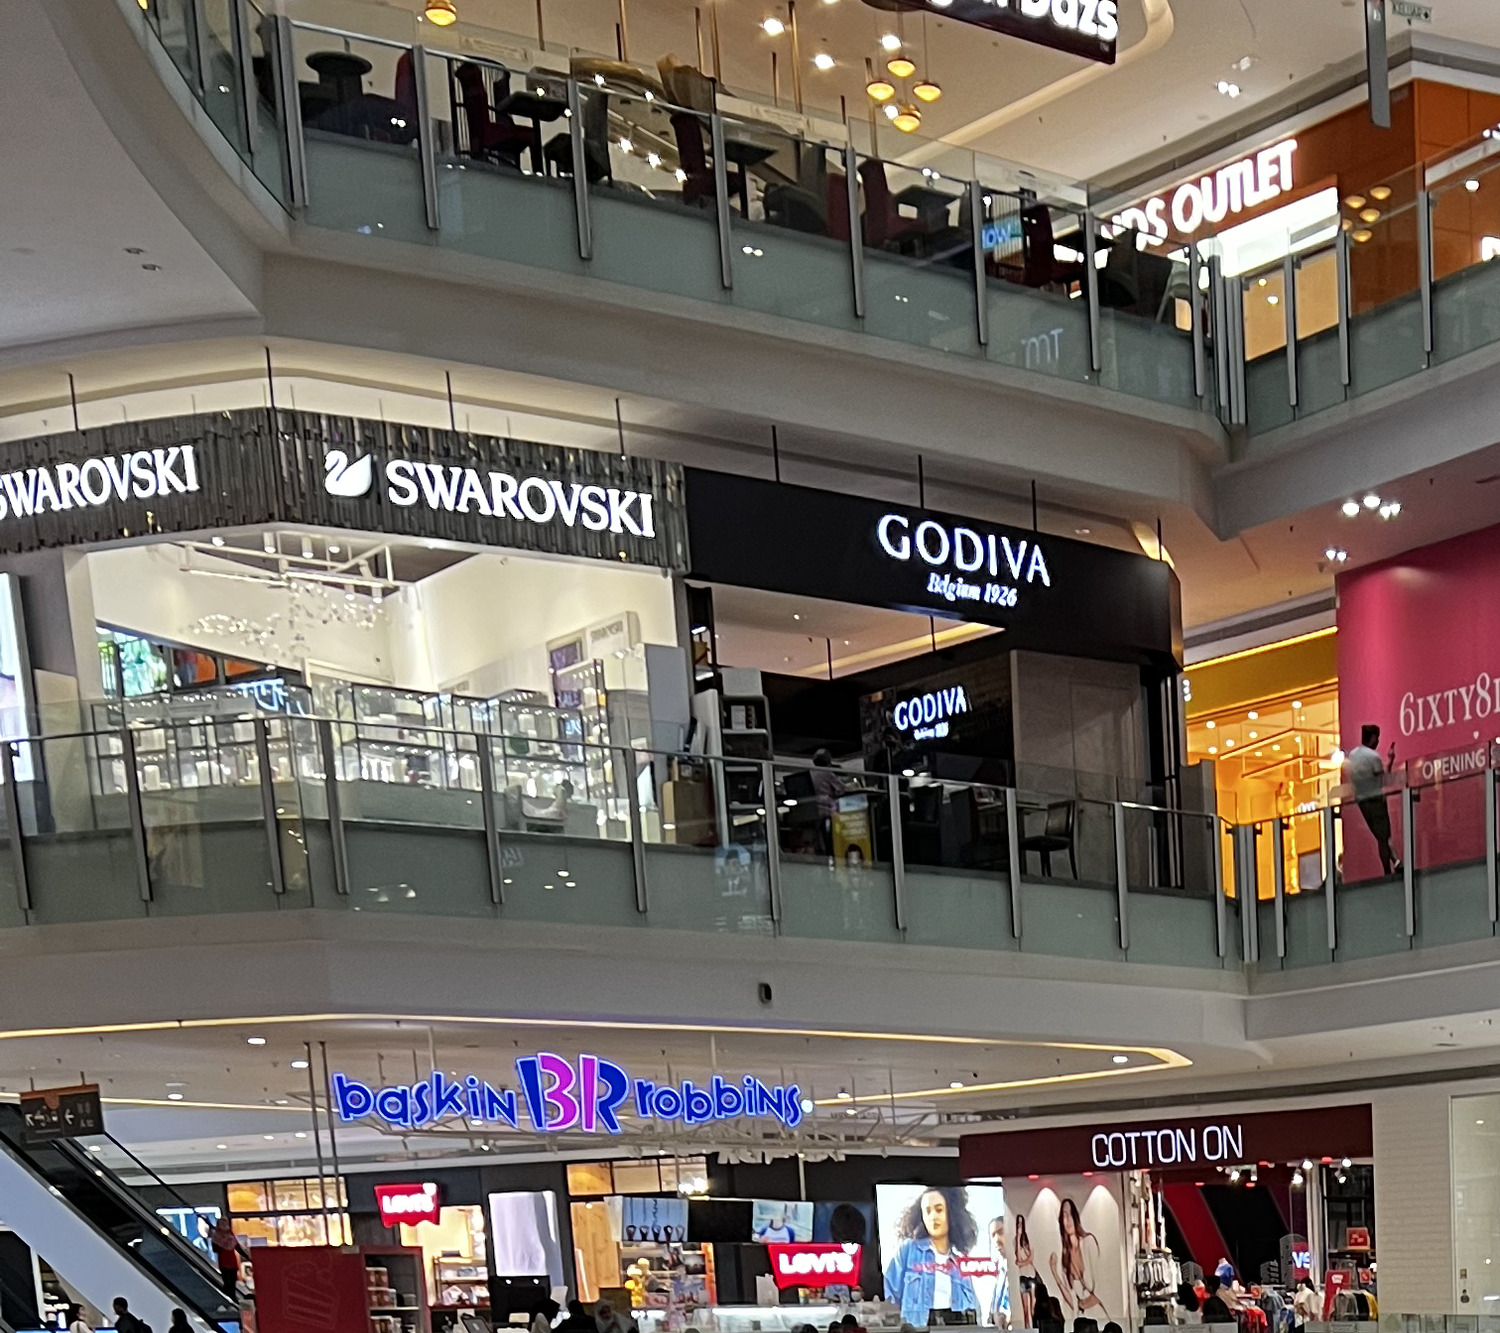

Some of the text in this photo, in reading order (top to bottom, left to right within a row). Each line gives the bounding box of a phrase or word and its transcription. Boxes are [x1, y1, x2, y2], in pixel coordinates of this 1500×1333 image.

[1172, 139, 1297, 234] OUTLET
[386, 459, 656, 539] SWAROVSKI
[877, 513, 1052, 588] GODIVA
[927, 572, 1018, 608] Belgium 1926
[893, 684, 968, 732] GODIVA
[1421, 748, 1487, 780] OPENING
[1092, 1124, 1243, 1168] COTTON ON
